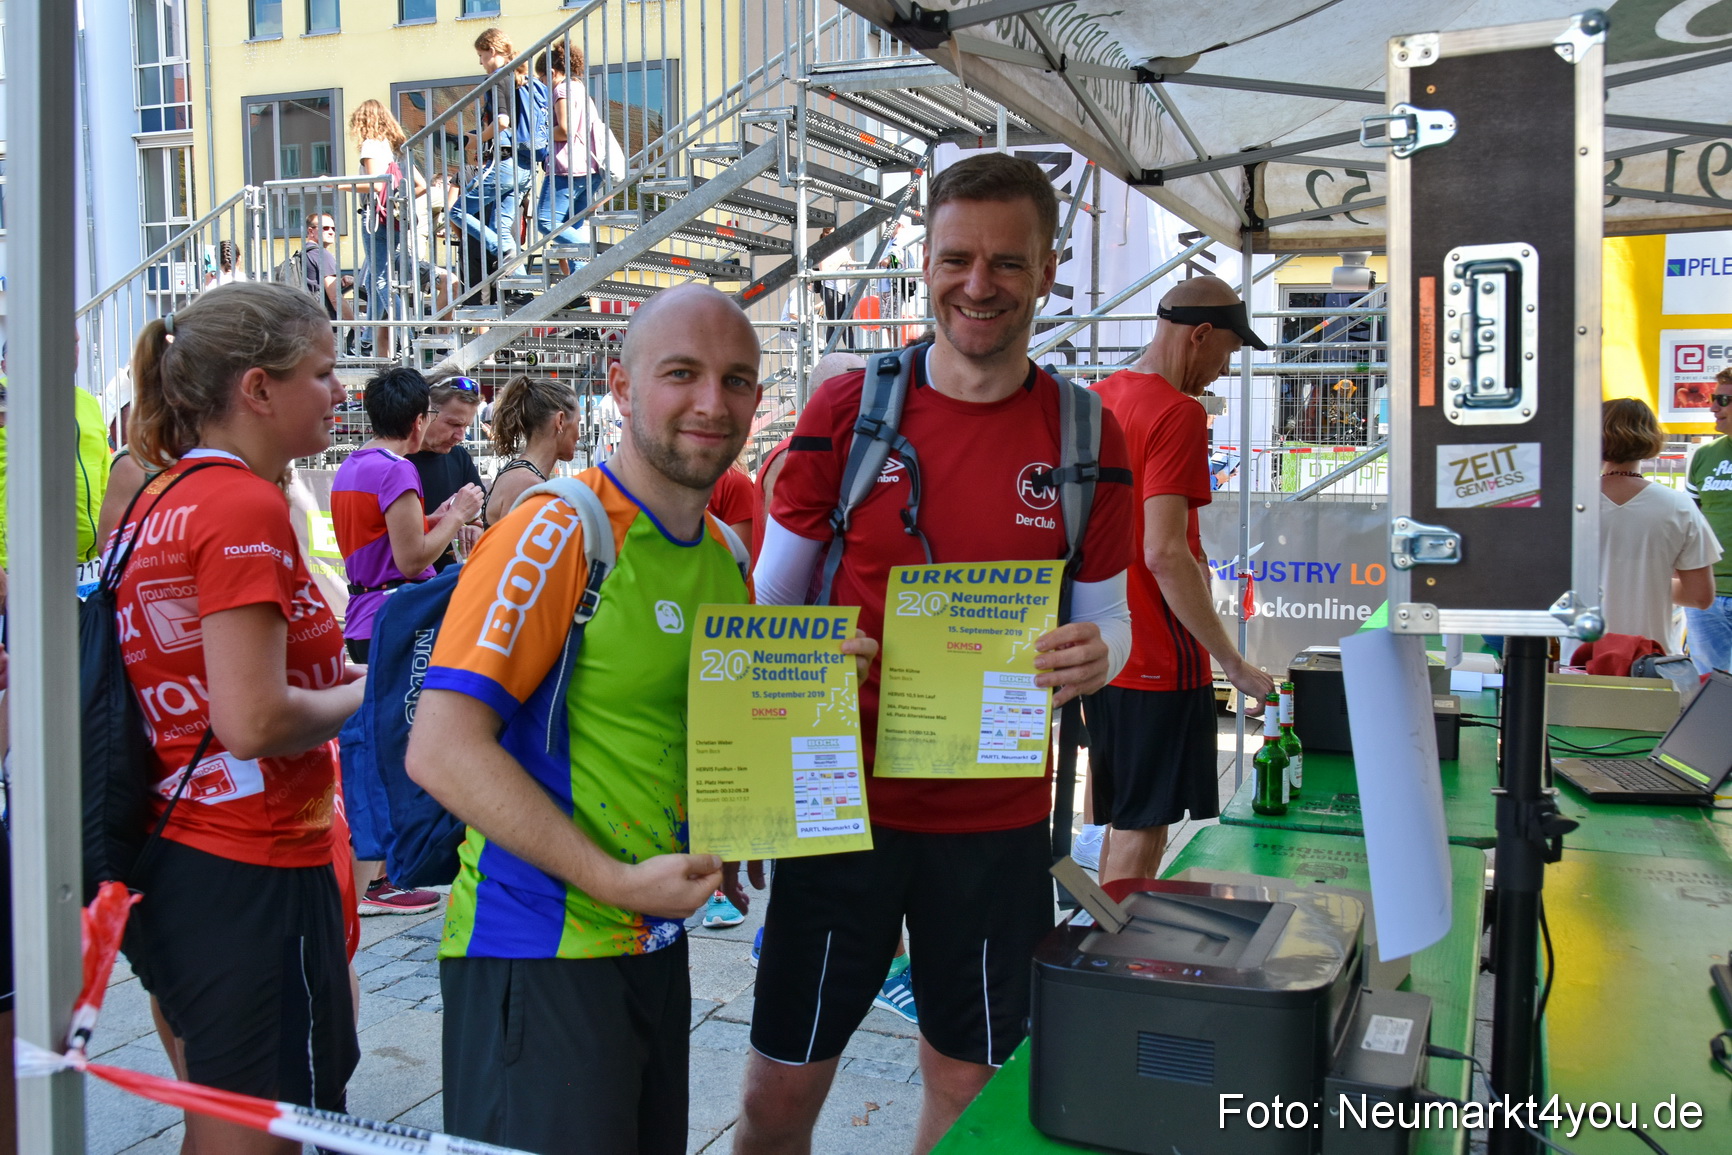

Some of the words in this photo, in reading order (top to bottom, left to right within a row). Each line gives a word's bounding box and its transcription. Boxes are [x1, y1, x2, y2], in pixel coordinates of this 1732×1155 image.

[1422, 324, 1432, 378] MONITOR
[1448, 444, 1518, 486] ZEIT
[878, 474, 900, 482] mbro
[1016, 513, 1034, 526] Der
[1034, 516, 1056, 530] Club
[224, 542, 282, 558] raumbox
[477, 497, 582, 658] BOCK
[901, 568, 1053, 584] URKUNDE
[1351, 563, 1386, 586] LO
[896, 591, 950, 617] 20
[951, 592, 1049, 606] Neumarkter
[950, 606, 1028, 622] Stadtlauf
[704, 616, 848, 640] URKUNDE
[960, 626, 1003, 636] September
[947, 642, 974, 650] DKMS
[700, 649, 752, 681] 20
[752, 650, 846, 664] Neumarkter
[752, 666, 826, 683] Stadtlauf
[764, 691, 806, 700] September
[752, 708, 779, 716] DKMS
